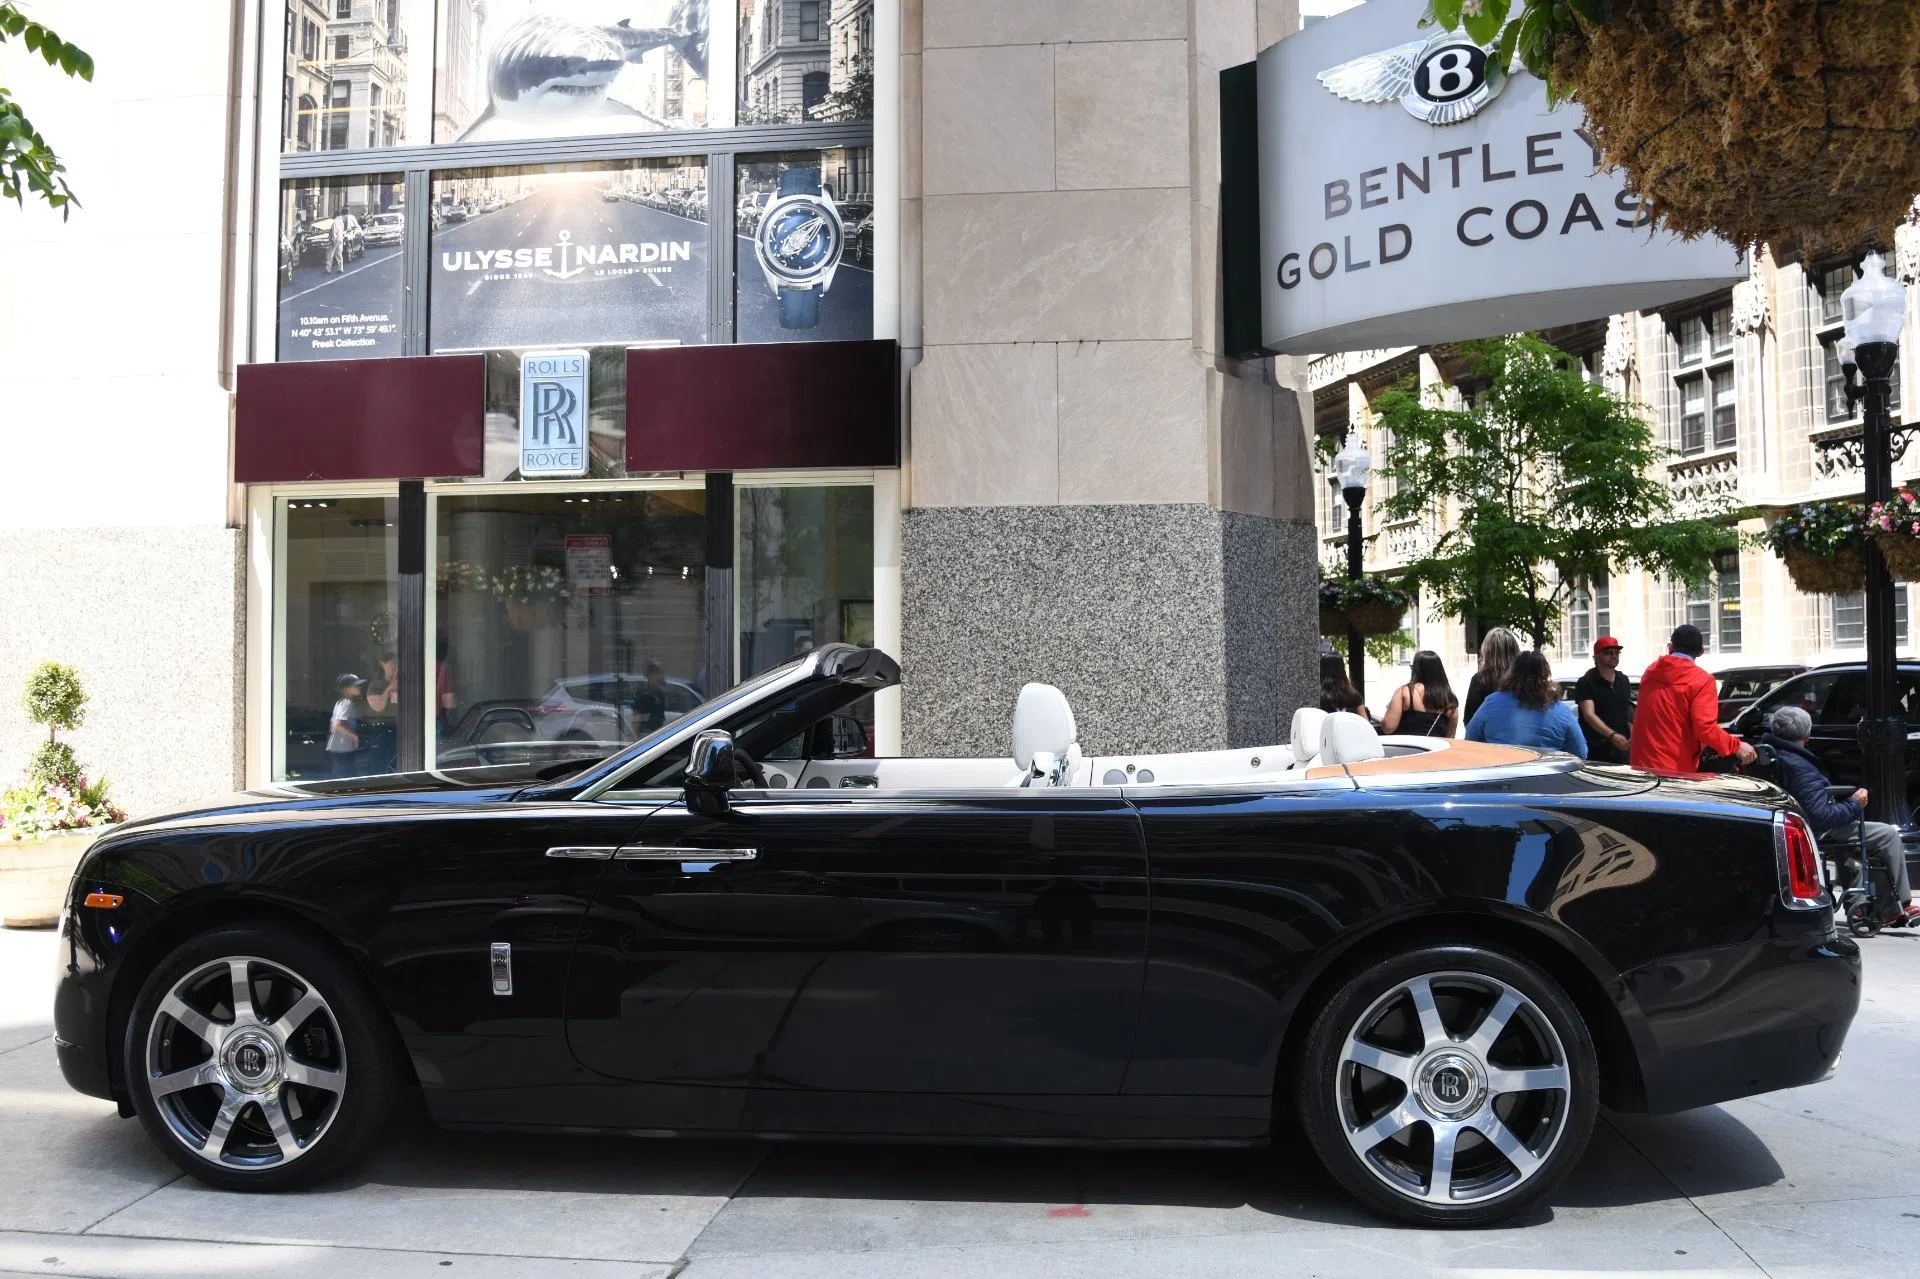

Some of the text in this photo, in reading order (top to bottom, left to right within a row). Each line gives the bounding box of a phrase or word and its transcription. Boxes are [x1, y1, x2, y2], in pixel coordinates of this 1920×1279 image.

[1426, 47, 1473, 97] B
[1277, 188, 1653, 290] GOLD COAS
[442, 241, 691, 271] ULYSSE NARDIN
[484, 273, 511, 281] SINCE
[595, 268, 605, 276] LE
[607, 267, 633, 276] LOCLE
[642, 266, 673, 274] SUISSE
[341, 314, 358, 324] Fifth
[291, 329, 298, 337] N
[343, 326, 352, 335] W
[312, 338, 376, 348] Freak Collection
[528, 360, 580, 374] ROLLS
[526, 452, 579, 467] ROYCE
